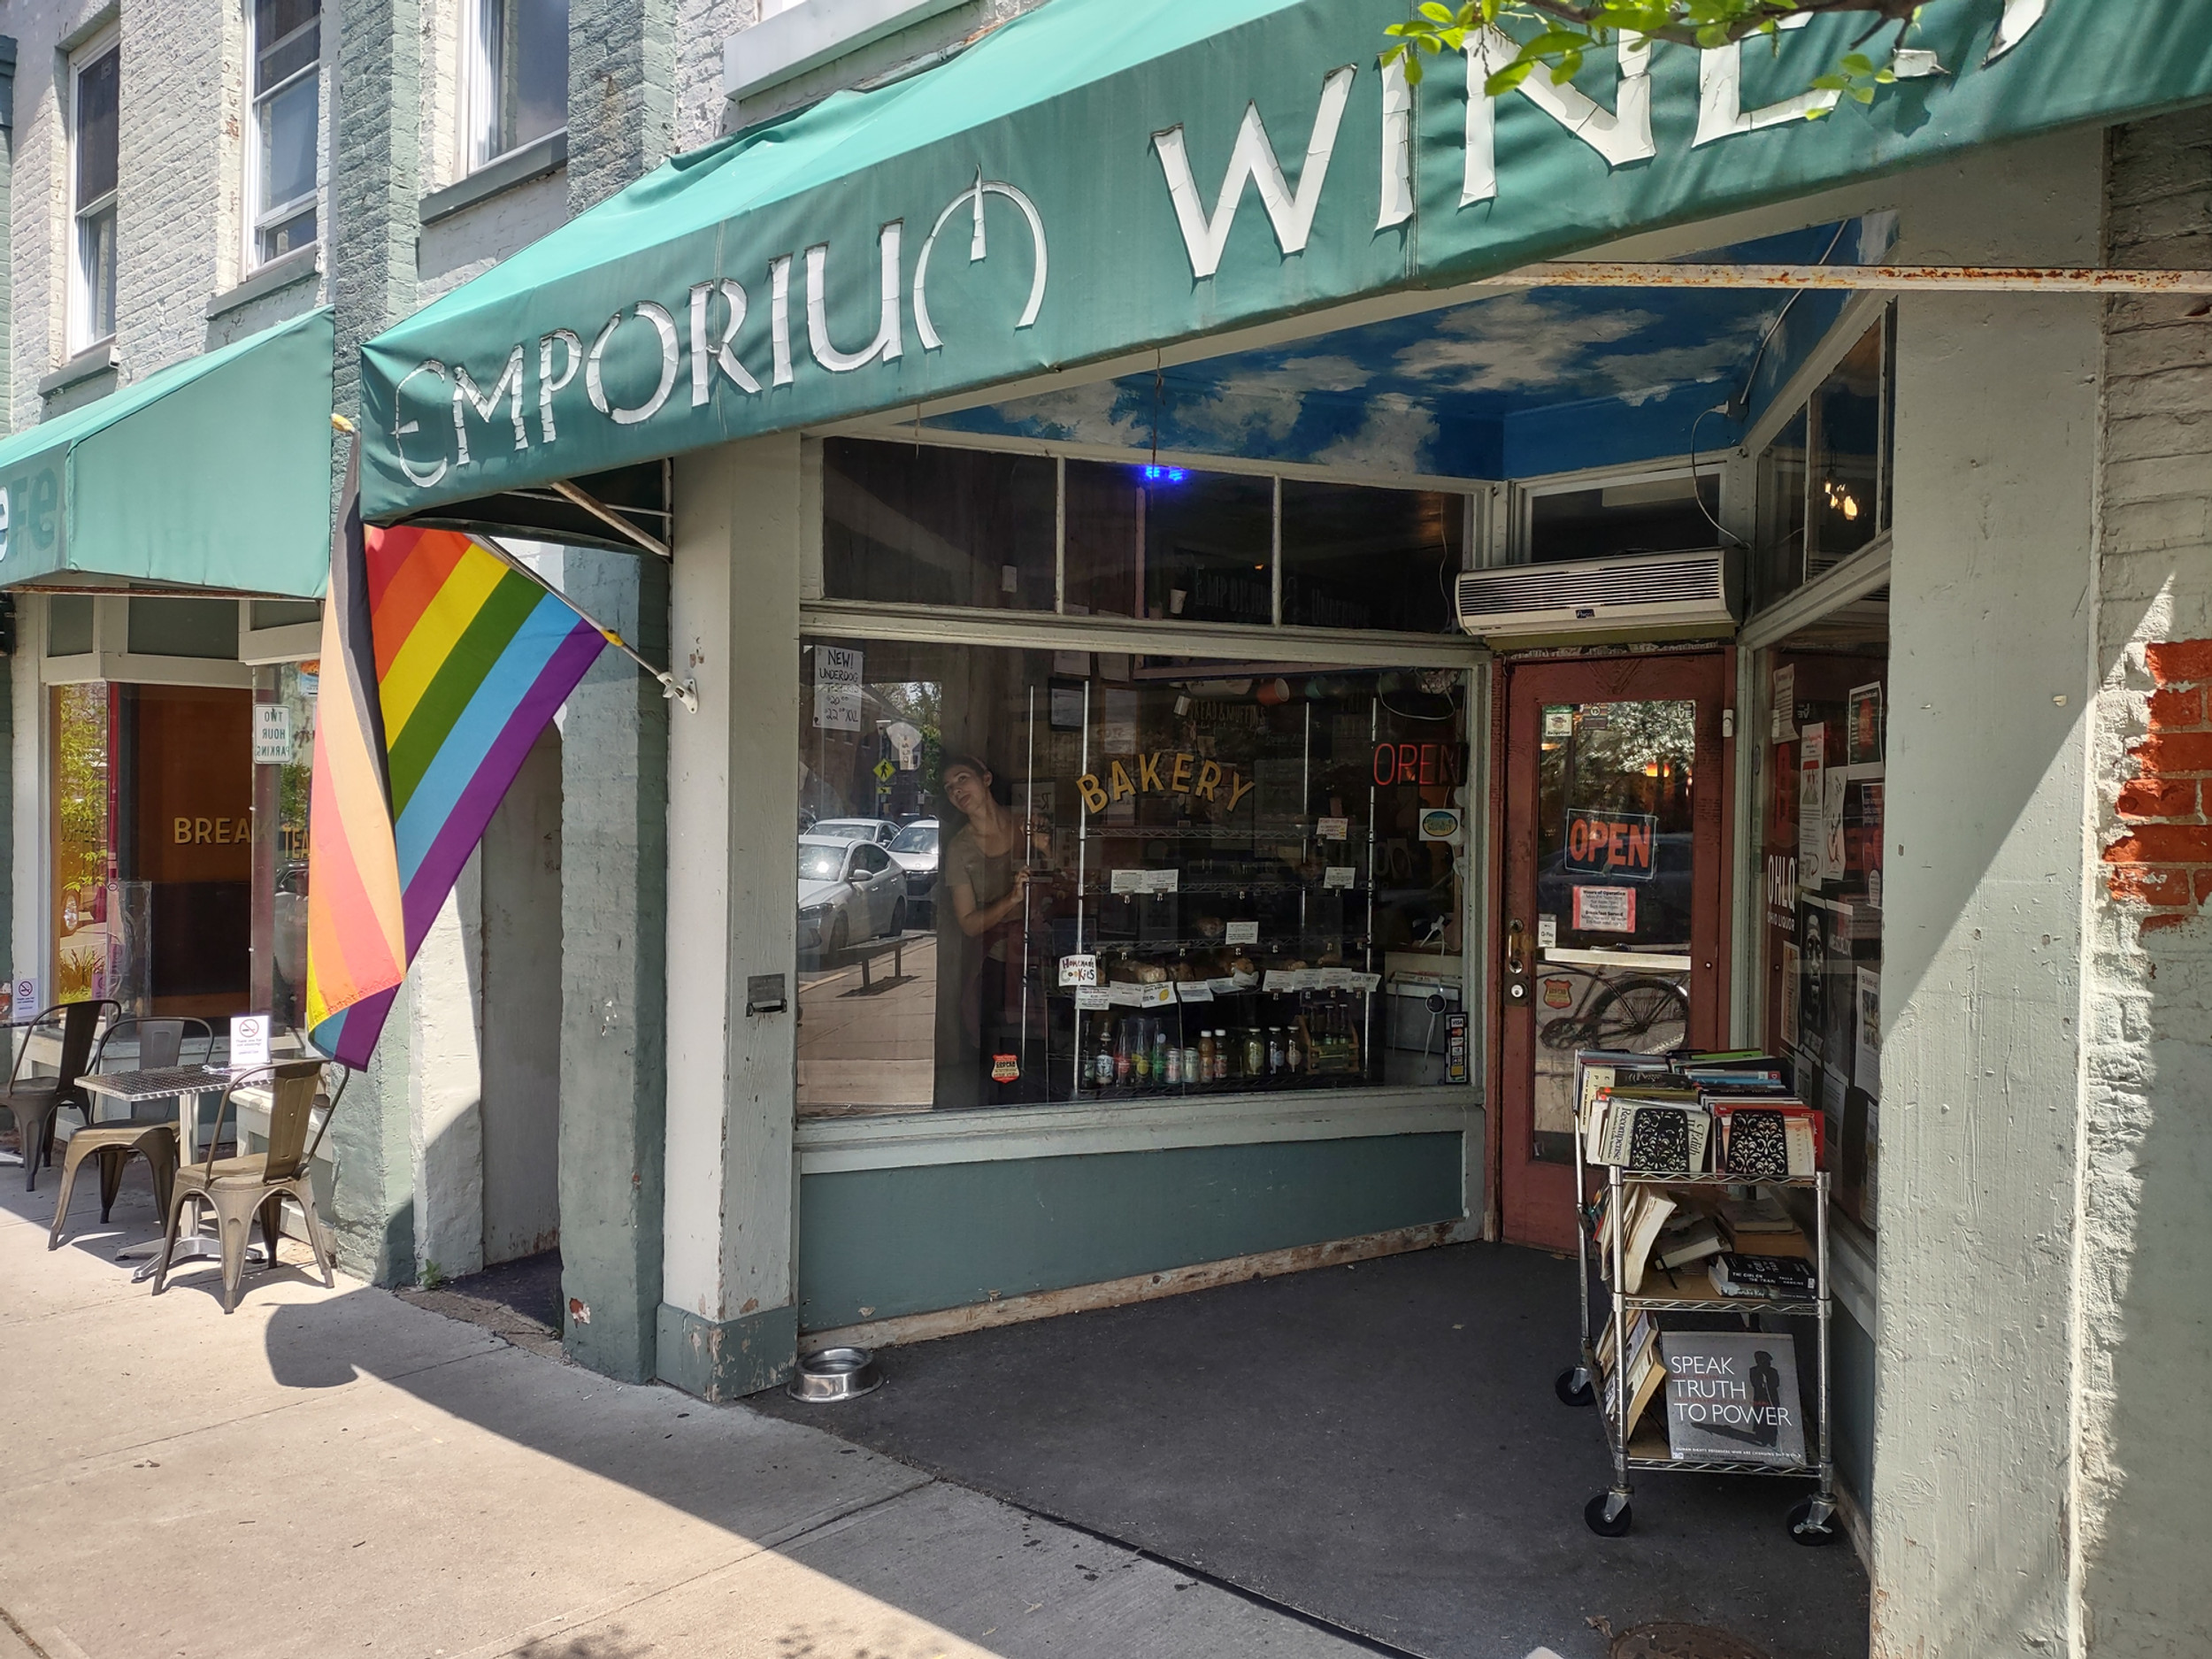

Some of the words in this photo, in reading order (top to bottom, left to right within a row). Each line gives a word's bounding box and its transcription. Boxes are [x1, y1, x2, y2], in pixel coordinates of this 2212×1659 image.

[390, 165, 1049, 489] EMPORIUM
[1150, 0, 2046, 279] WINE
[819, 668, 858, 682] UNDERDOG
[827, 649, 854, 669] NEW!
[1076, 752, 1256, 814] BAKERY
[1373, 742, 1460, 786] OPEN
[1569, 818, 1651, 869] OPEN
[1767, 854, 1795, 914] OHLQ
[1613, 1107, 1632, 1161] Recompense
[1671, 1356, 1735, 1375] SPEAK
[1672, 1379, 1747, 1400] TRUTH
[1673, 1402, 1707, 1423] TO
[1711, 1403, 1793, 1427] POWER
